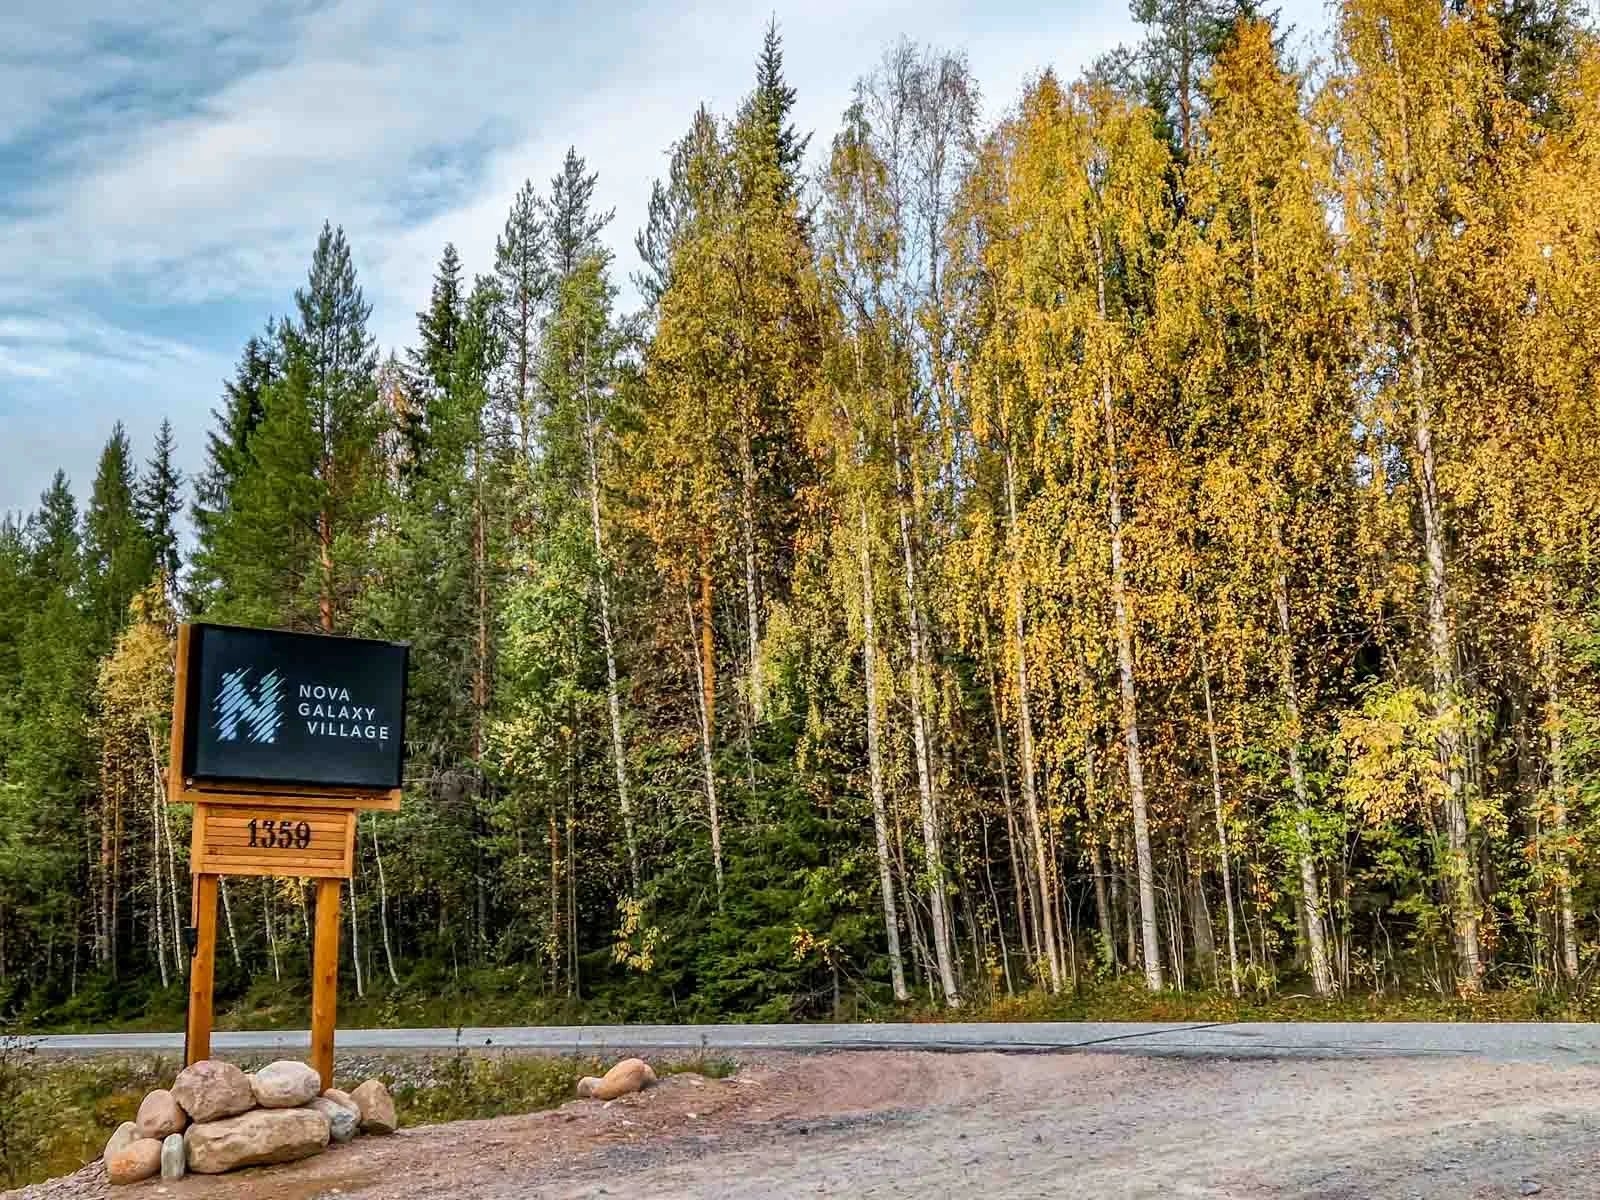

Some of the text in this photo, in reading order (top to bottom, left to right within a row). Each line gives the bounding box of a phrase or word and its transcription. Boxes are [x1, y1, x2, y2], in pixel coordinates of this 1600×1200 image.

[299, 684, 350, 701] NOVA
[298, 702, 376, 721] GALAXY
[307, 721, 389, 740] VILLAGE
[248, 818, 311, 849] 1359
